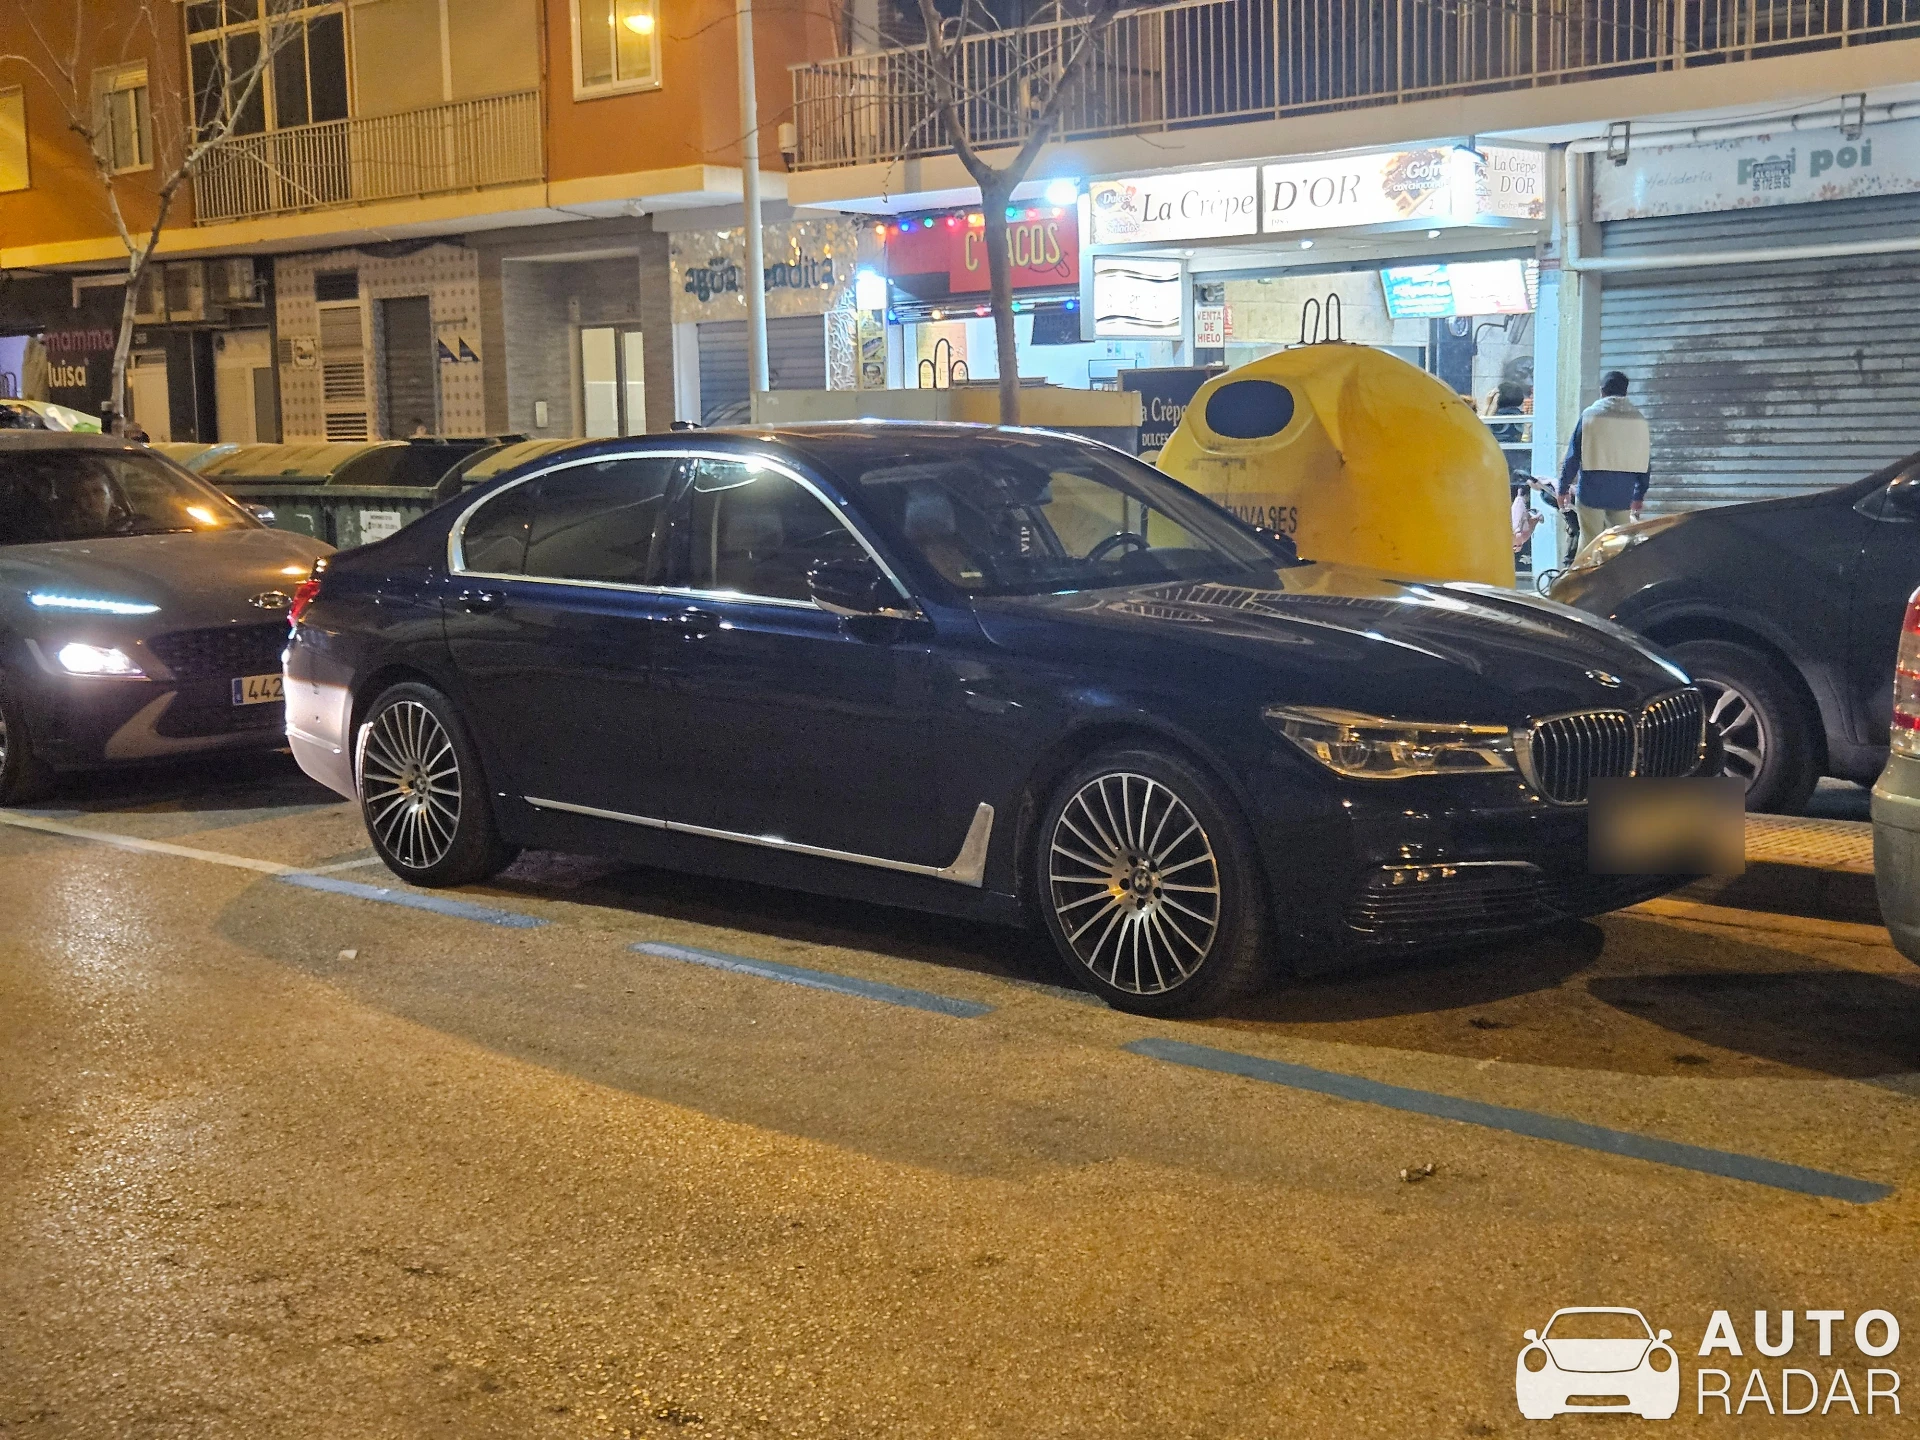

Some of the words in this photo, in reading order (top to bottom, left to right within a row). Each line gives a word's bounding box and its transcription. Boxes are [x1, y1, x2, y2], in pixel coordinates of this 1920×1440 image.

[1494, 155, 1506, 171] La
[1810, 138, 1872, 178] poi
[1500, 175, 1535, 194] D'OR
[1142, 193, 1172, 223] La
[1271, 174, 1361, 212] D'OR
[764, 247, 835, 292] endita
[1197, 310, 1222, 321] VENTA
[1203, 322, 1215, 332] DE
[1197, 333, 1221, 344] HIELO
[48, 360, 87, 388] luisa
[1225, 505, 1298, 534] NVASES
